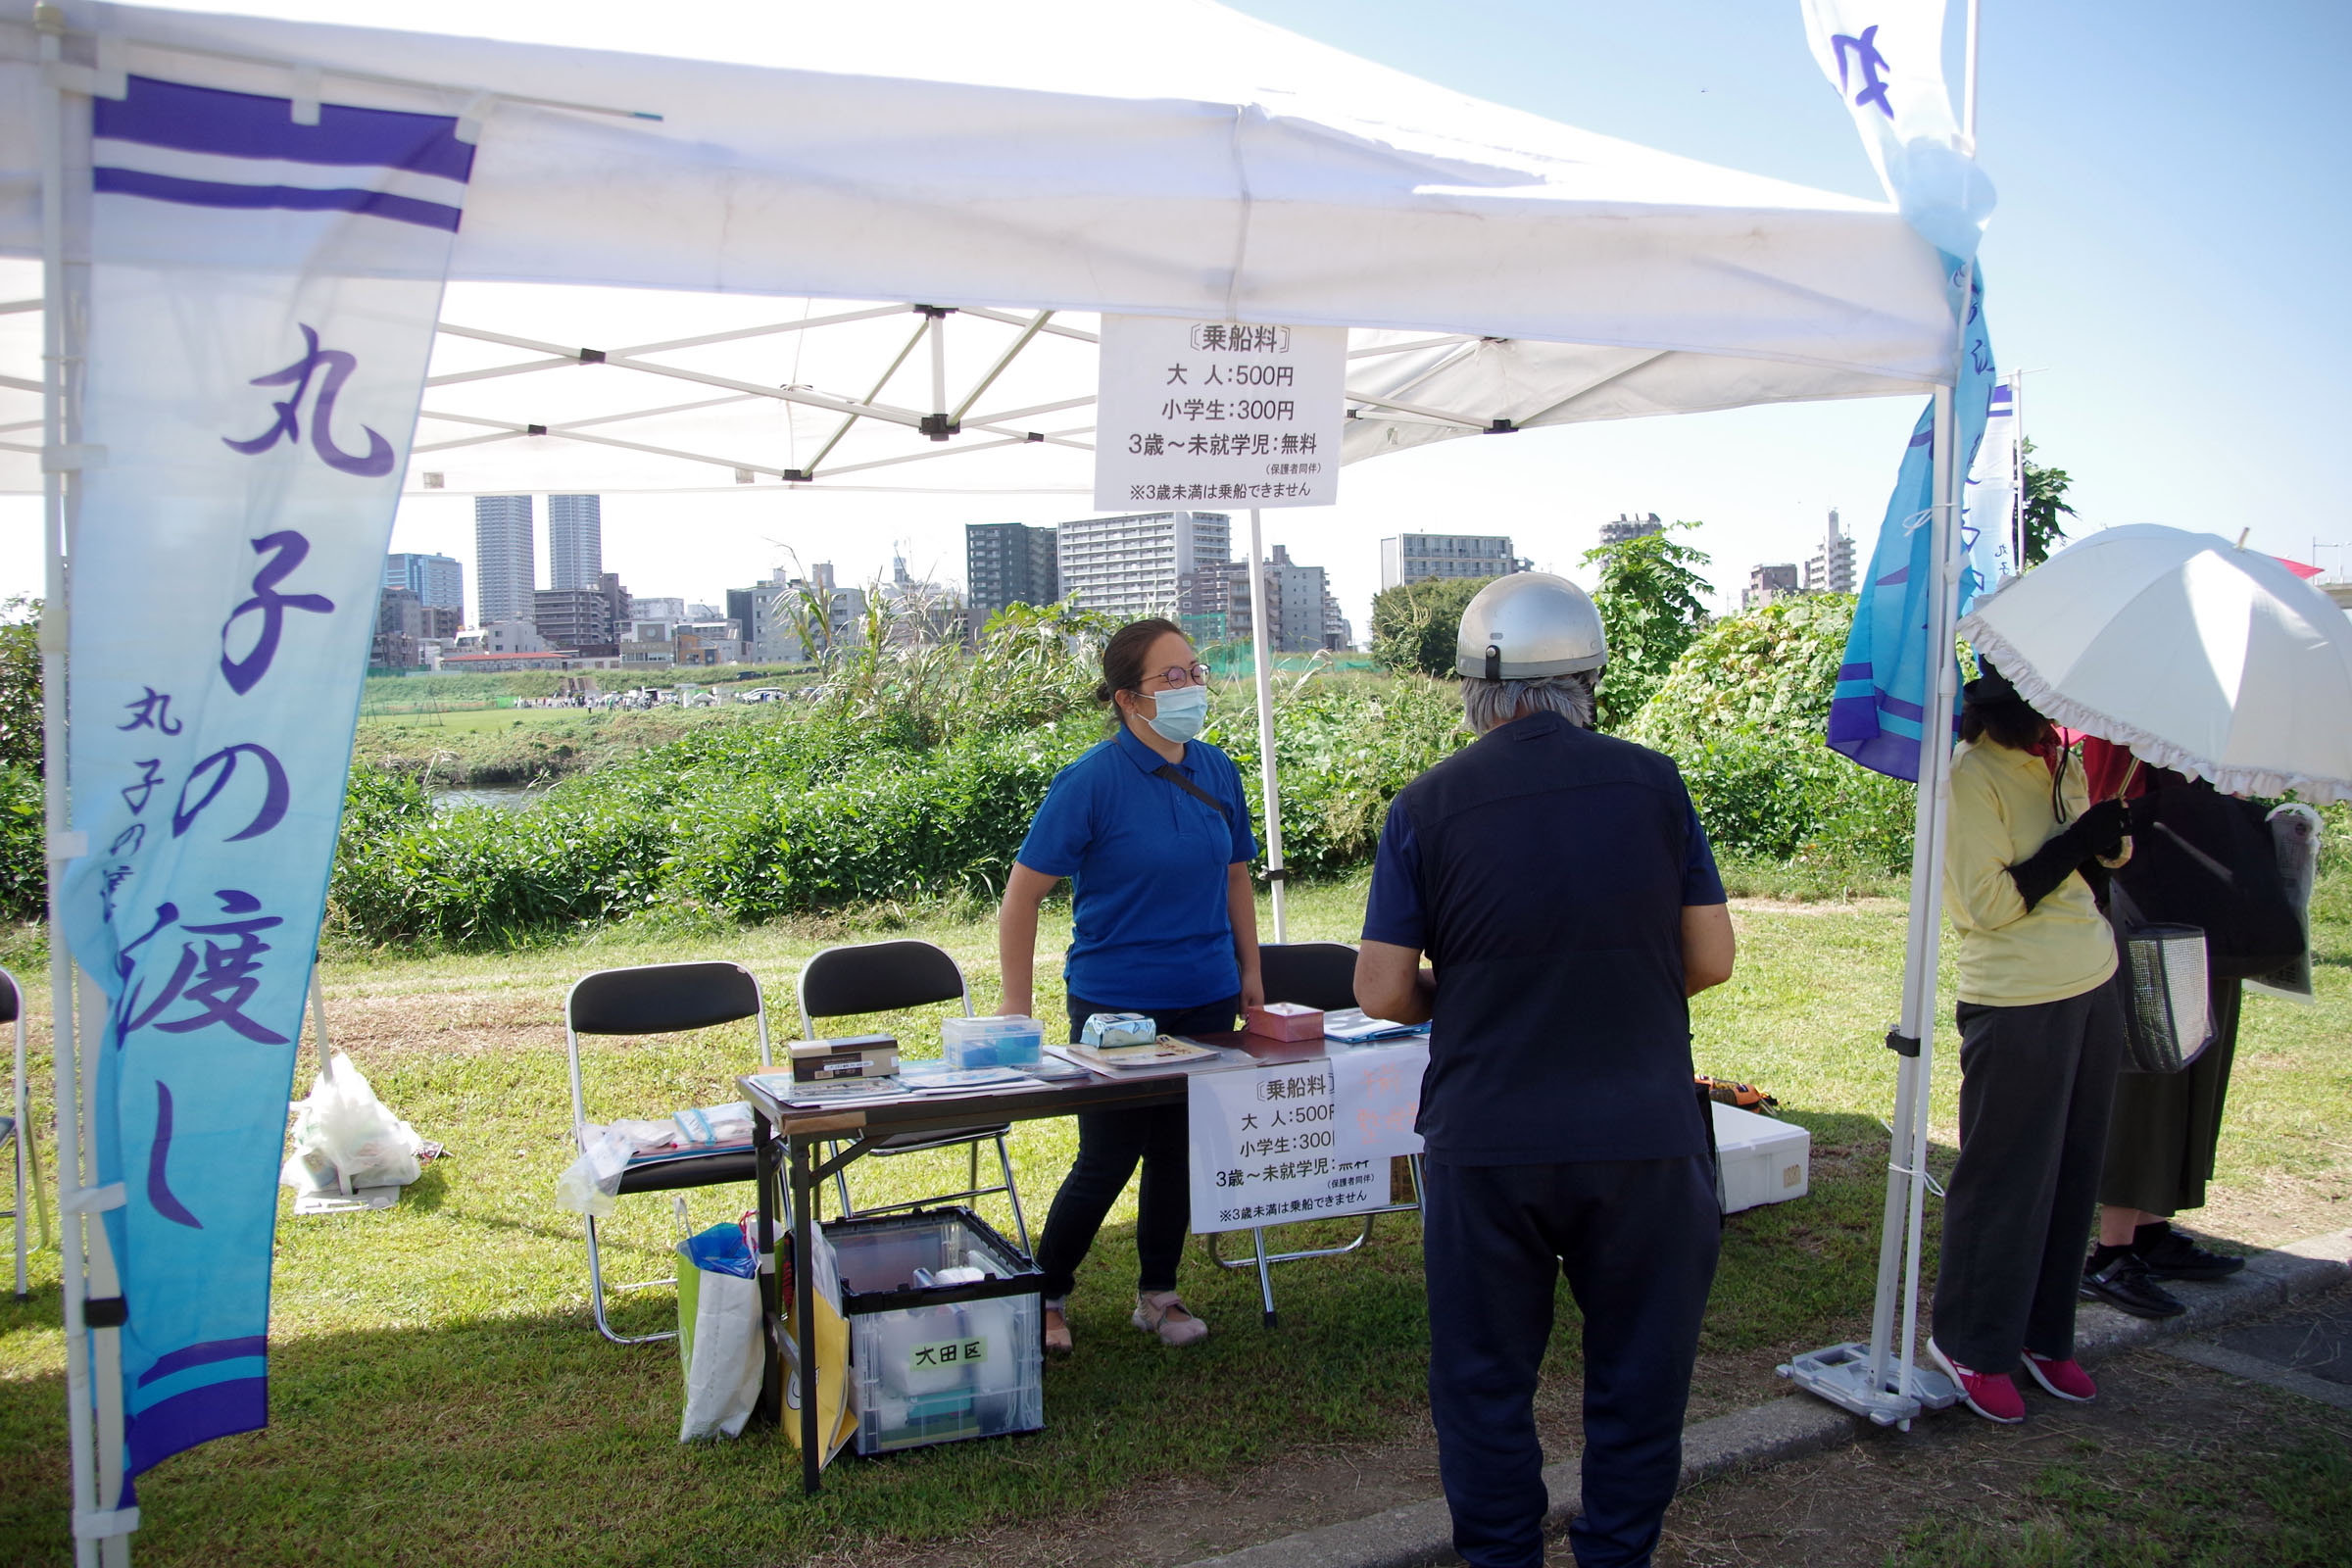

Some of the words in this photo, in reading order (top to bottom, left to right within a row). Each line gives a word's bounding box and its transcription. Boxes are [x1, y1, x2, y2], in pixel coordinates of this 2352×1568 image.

[1161, 398, 1295, 421] 小学生:300円
[1130, 481, 1311, 501] ※3歳未満は乗船できません
[116, 322, 395, 1230] 丸子の渡し
[1240, 1130, 1335, 1158] 小学生:300
[1219, 1190, 1367, 1223] ※3歳未満は乗船できません
[915, 1341, 981, 1365] 大田区
